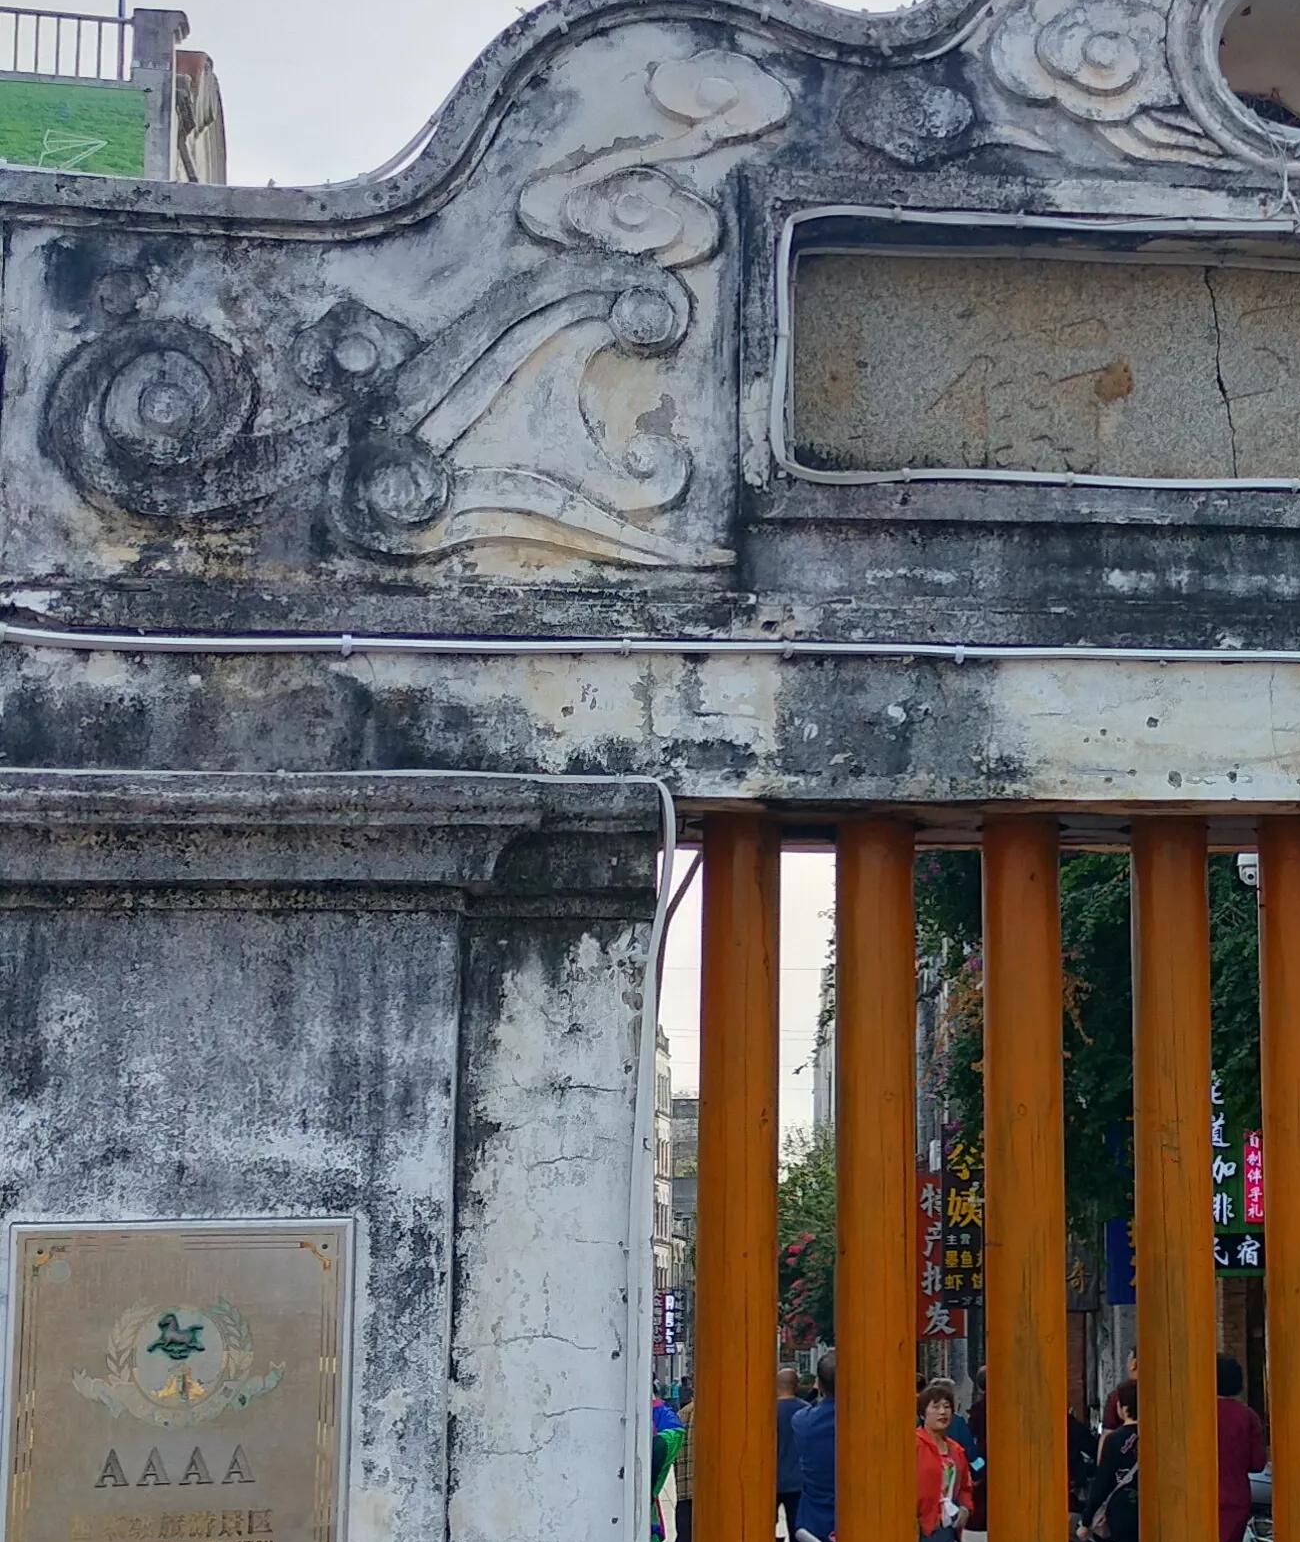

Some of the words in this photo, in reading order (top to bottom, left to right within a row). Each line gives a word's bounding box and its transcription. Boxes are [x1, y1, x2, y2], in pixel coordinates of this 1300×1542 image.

[94, 1443, 256, 1488] AAAA
[70, 1509, 273, 1540] 级旅游景区
